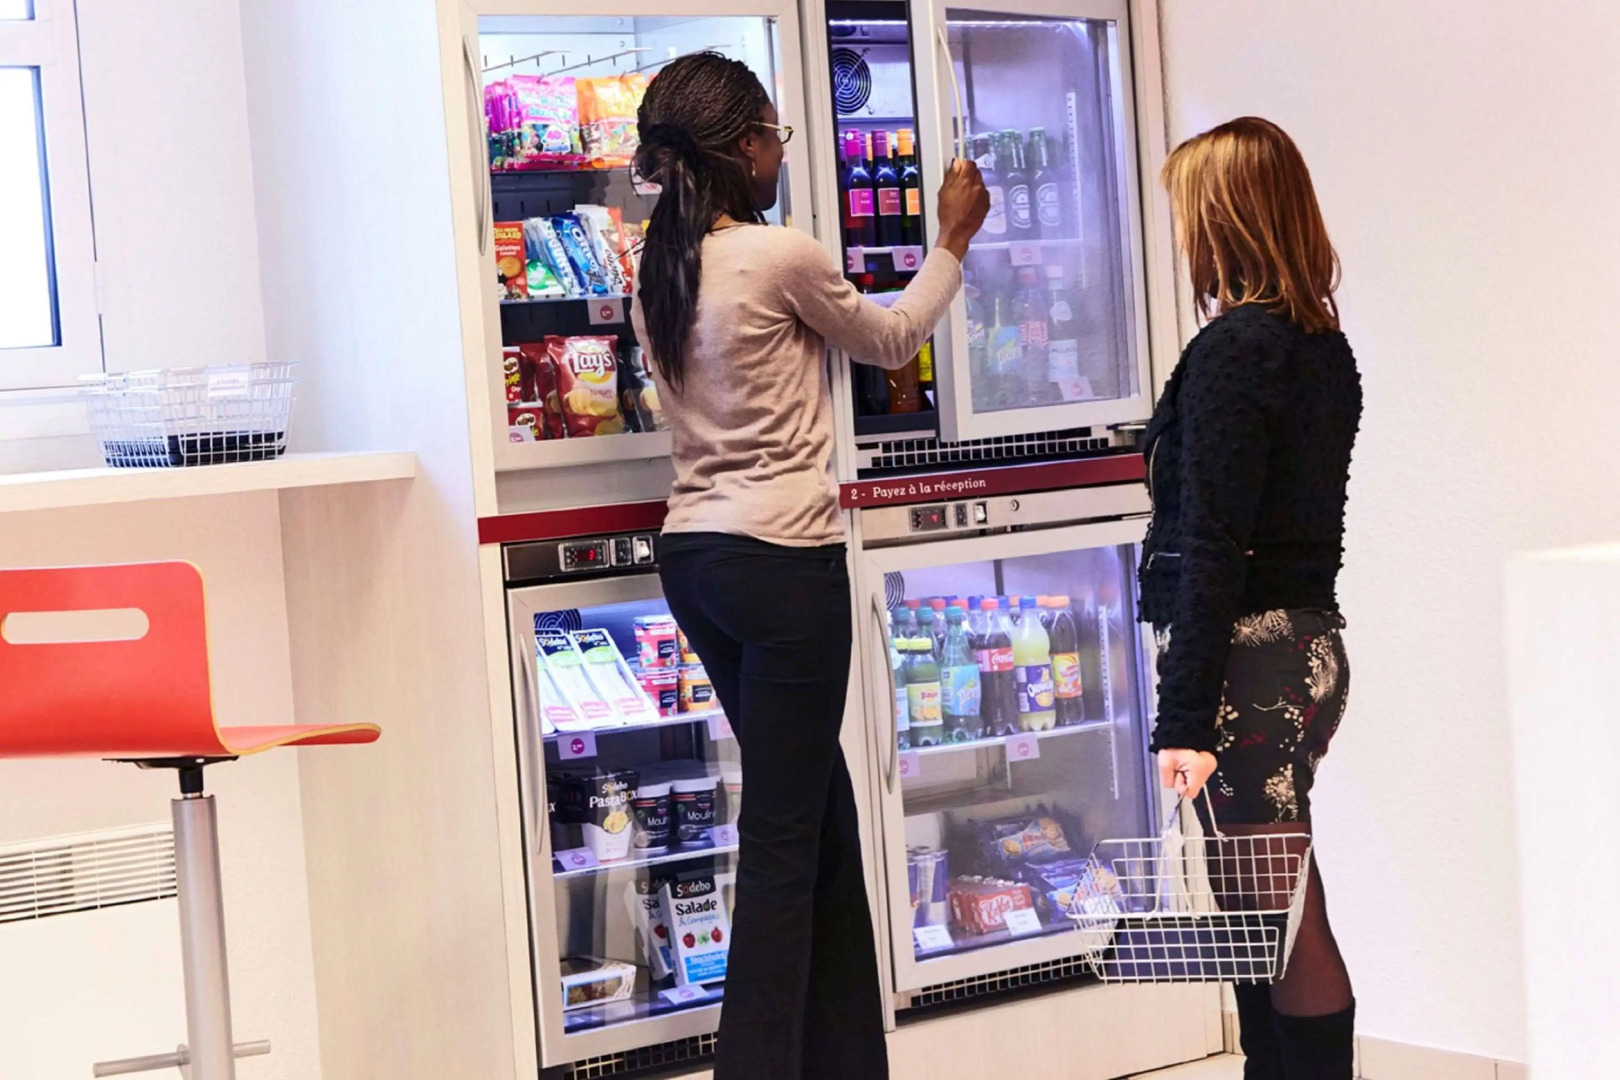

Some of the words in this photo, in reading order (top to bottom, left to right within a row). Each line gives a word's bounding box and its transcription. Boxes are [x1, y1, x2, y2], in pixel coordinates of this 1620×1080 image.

[570, 351, 612, 376] Lay's
[850, 488, 859, 500] 2
[872, 486, 906, 499] Payez
[908, 484, 917, 495] à
[919, 482, 931, 494] la
[934, 478, 987, 492] réception
[677, 881, 711, 897] Sodebo
[675, 899, 717, 916] Salade
